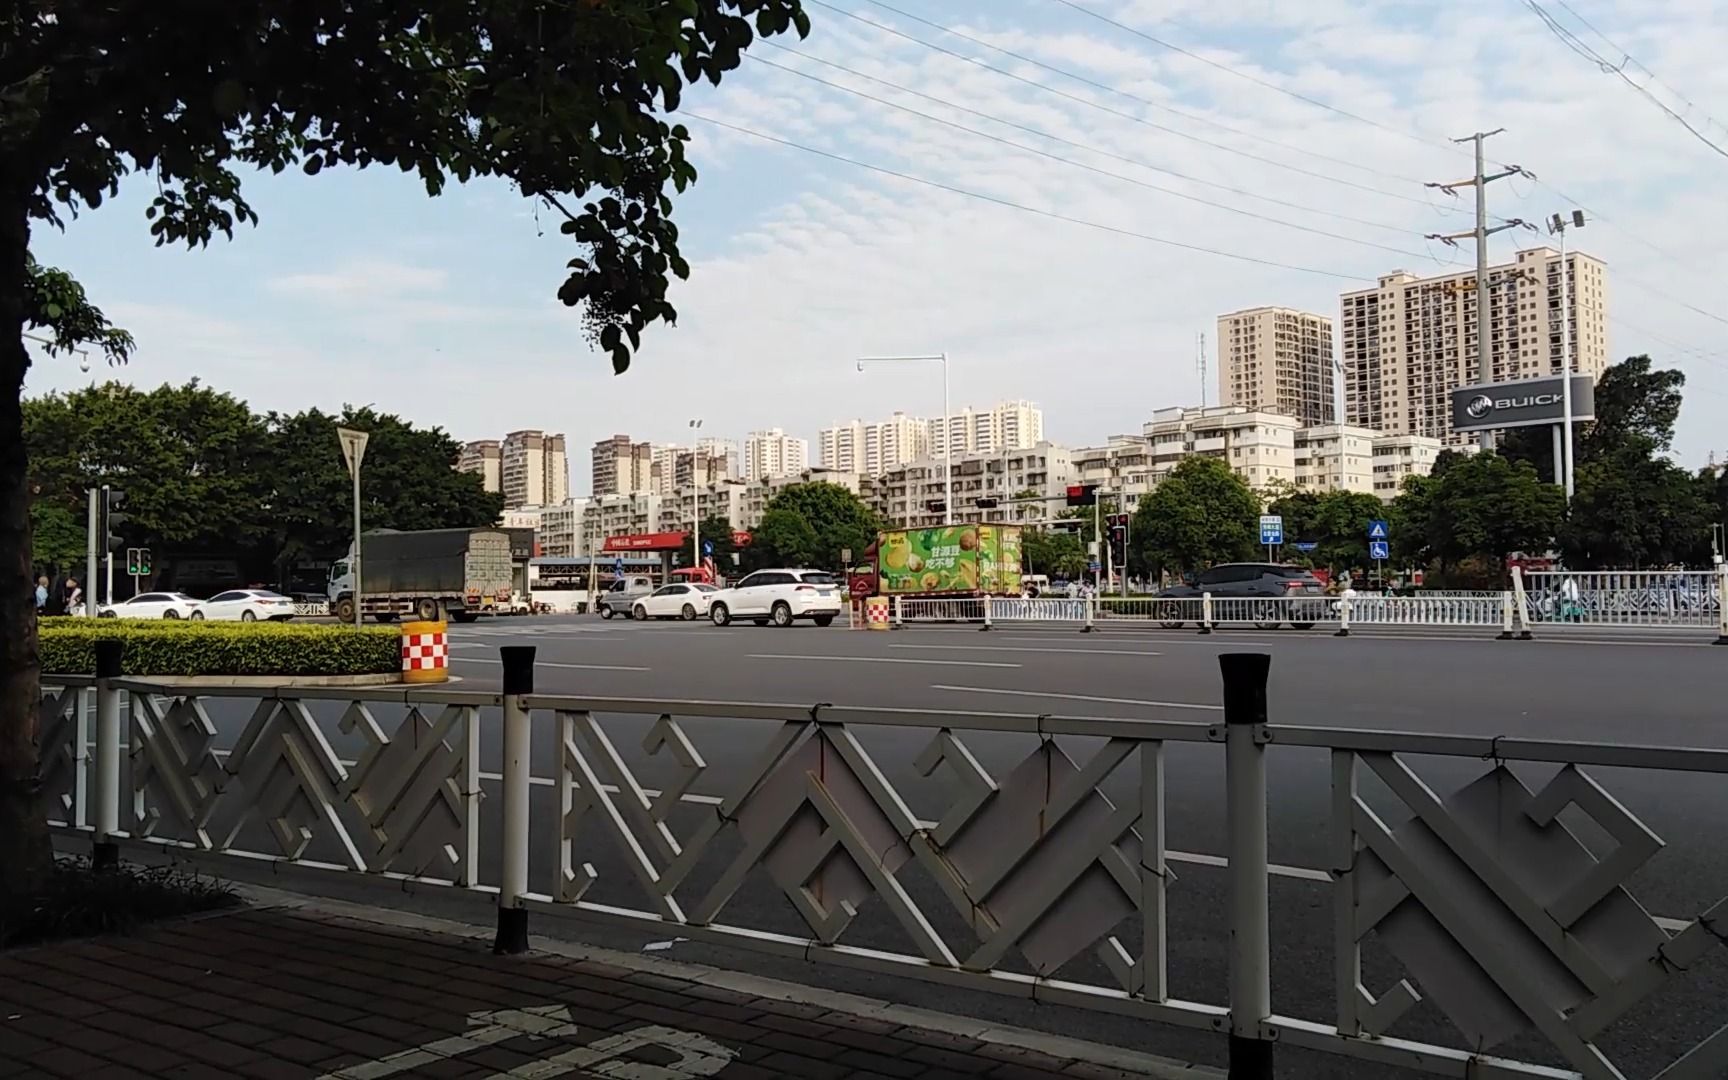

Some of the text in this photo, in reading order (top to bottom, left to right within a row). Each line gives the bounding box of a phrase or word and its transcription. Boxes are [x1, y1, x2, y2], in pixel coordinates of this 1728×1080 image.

[1494, 394, 1565, 409] BUICK
[925, 557, 955, 569] 吃不够
